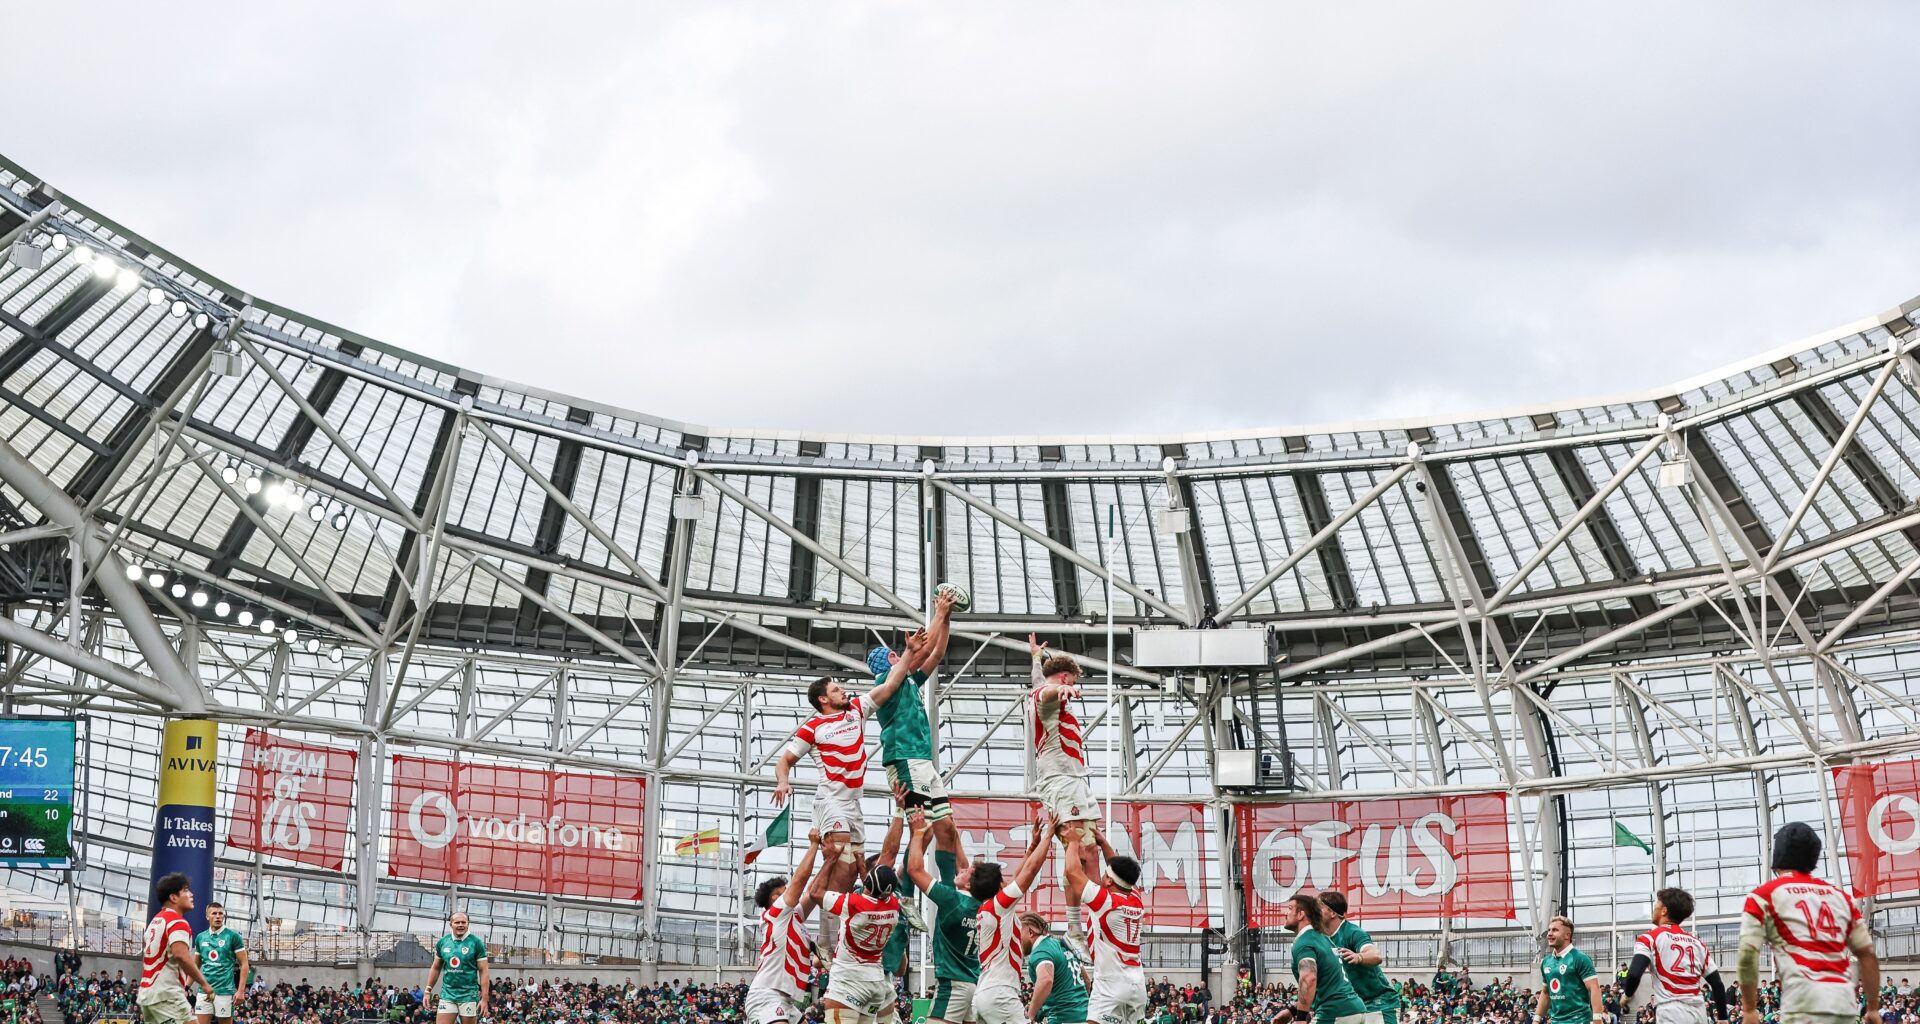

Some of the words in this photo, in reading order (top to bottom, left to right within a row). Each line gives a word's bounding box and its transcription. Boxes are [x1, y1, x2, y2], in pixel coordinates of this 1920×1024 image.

[167, 758, 217, 773] AVIVA
[43, 789, 58, 801] 22
[274, 775, 307, 800] OF
[45, 809, 59, 820] 10
[163, 817, 172, 830] It
[174, 817, 213, 833] Takes
[261, 800, 316, 851] US
[466, 812, 624, 850] vodafone
[166, 834, 207, 849] Aviva
[1784, 886, 1834, 896] TOSHIBA
[867, 912, 894, 920] TOSHIBA
[1794, 899, 1842, 940] 14
[859, 923, 893, 949] 20
[1123, 917, 1140, 944] 17
[1670, 943, 1695, 974] 21
